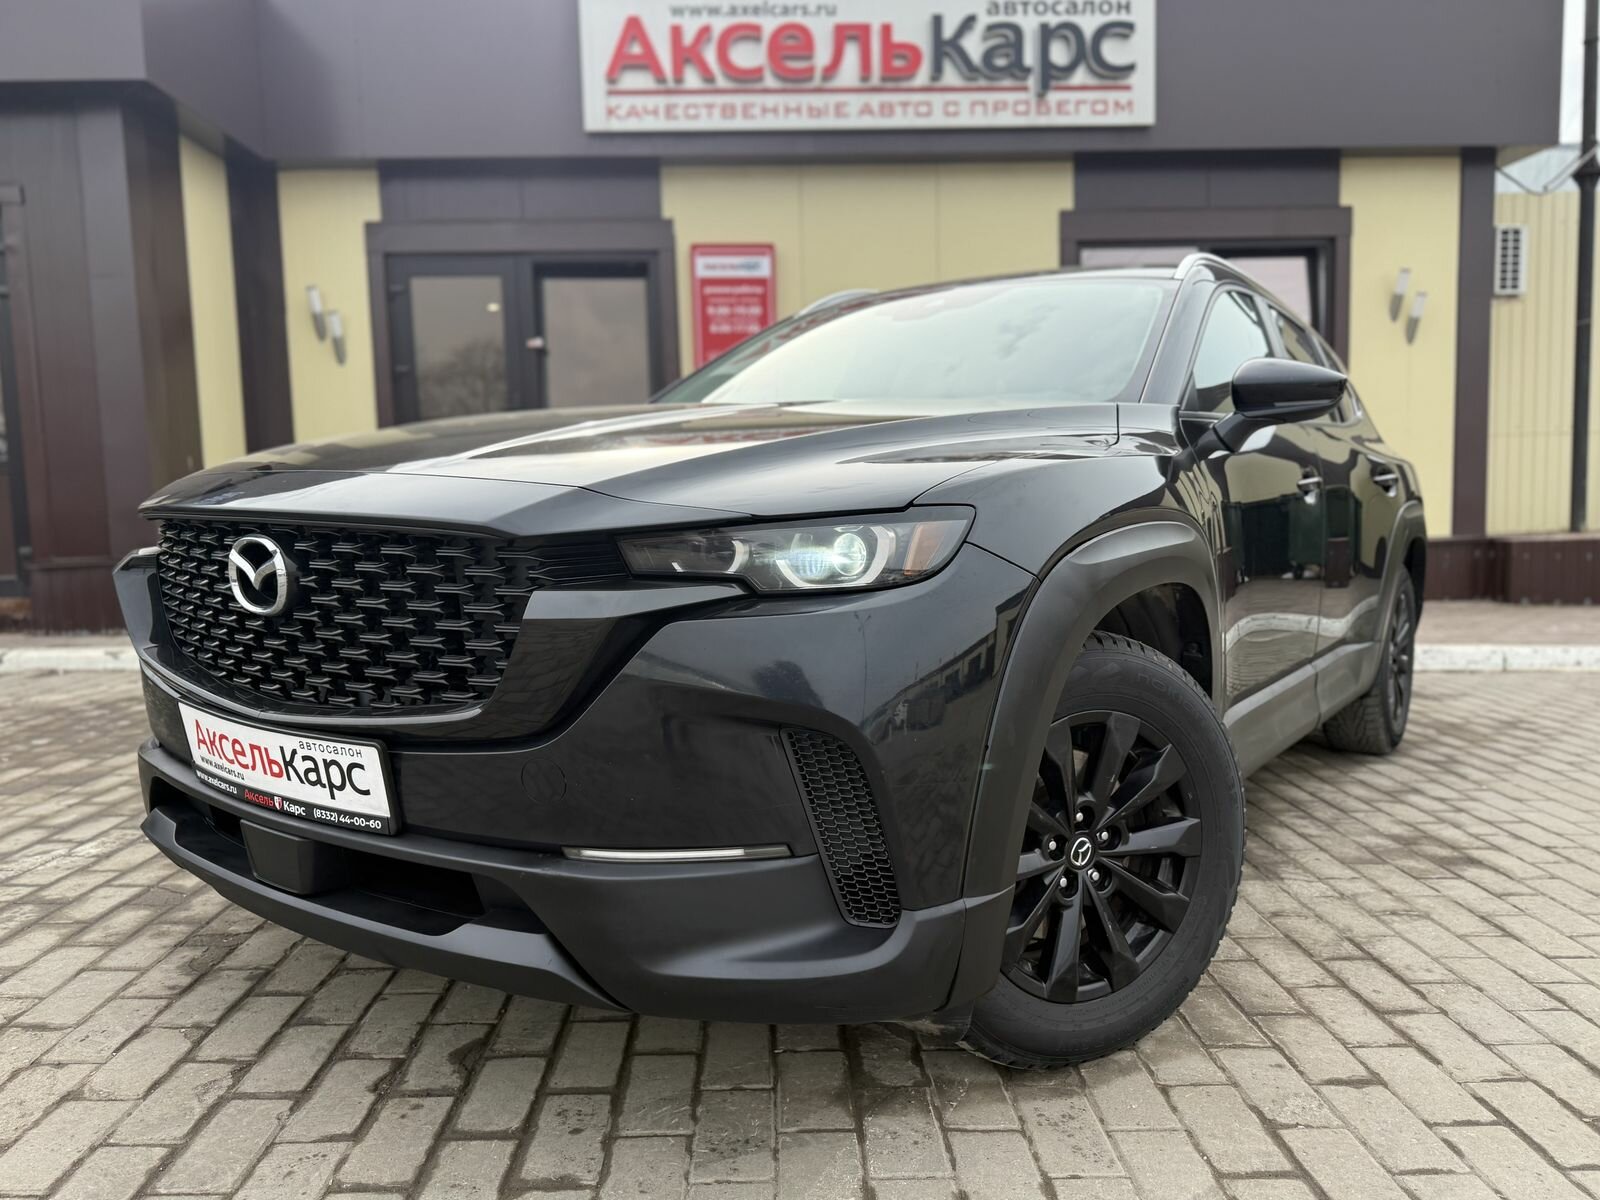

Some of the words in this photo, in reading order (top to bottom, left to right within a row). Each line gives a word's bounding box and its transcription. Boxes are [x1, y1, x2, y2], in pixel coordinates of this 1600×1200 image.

[670, 0, 837, 18] www.axelcars.ru
[986, 0, 1132, 17] автосалон
[606, 13, 1136, 97] АксельКарс
[606, 99, 850, 122] КАЧЕСТВЕННЫЕ
[857, 99, 932, 119] АВТО
[943, 99, 959, 118] С
[970, 98, 1135, 118] ПРОБЕГОМ
[195, 719, 371, 800] АксельКарс
[298, 739, 363, 759] автосалон
[200, 755, 245, 781] www.axelcars.ru
[195, 769, 238, 794] www.axelcars.ru
[244, 789, 274, 807] Аксель
[283, 803, 306, 816] Карс
[313, 808, 338, 823] (8332)
[339, 815, 382, 830] 44-00-60
